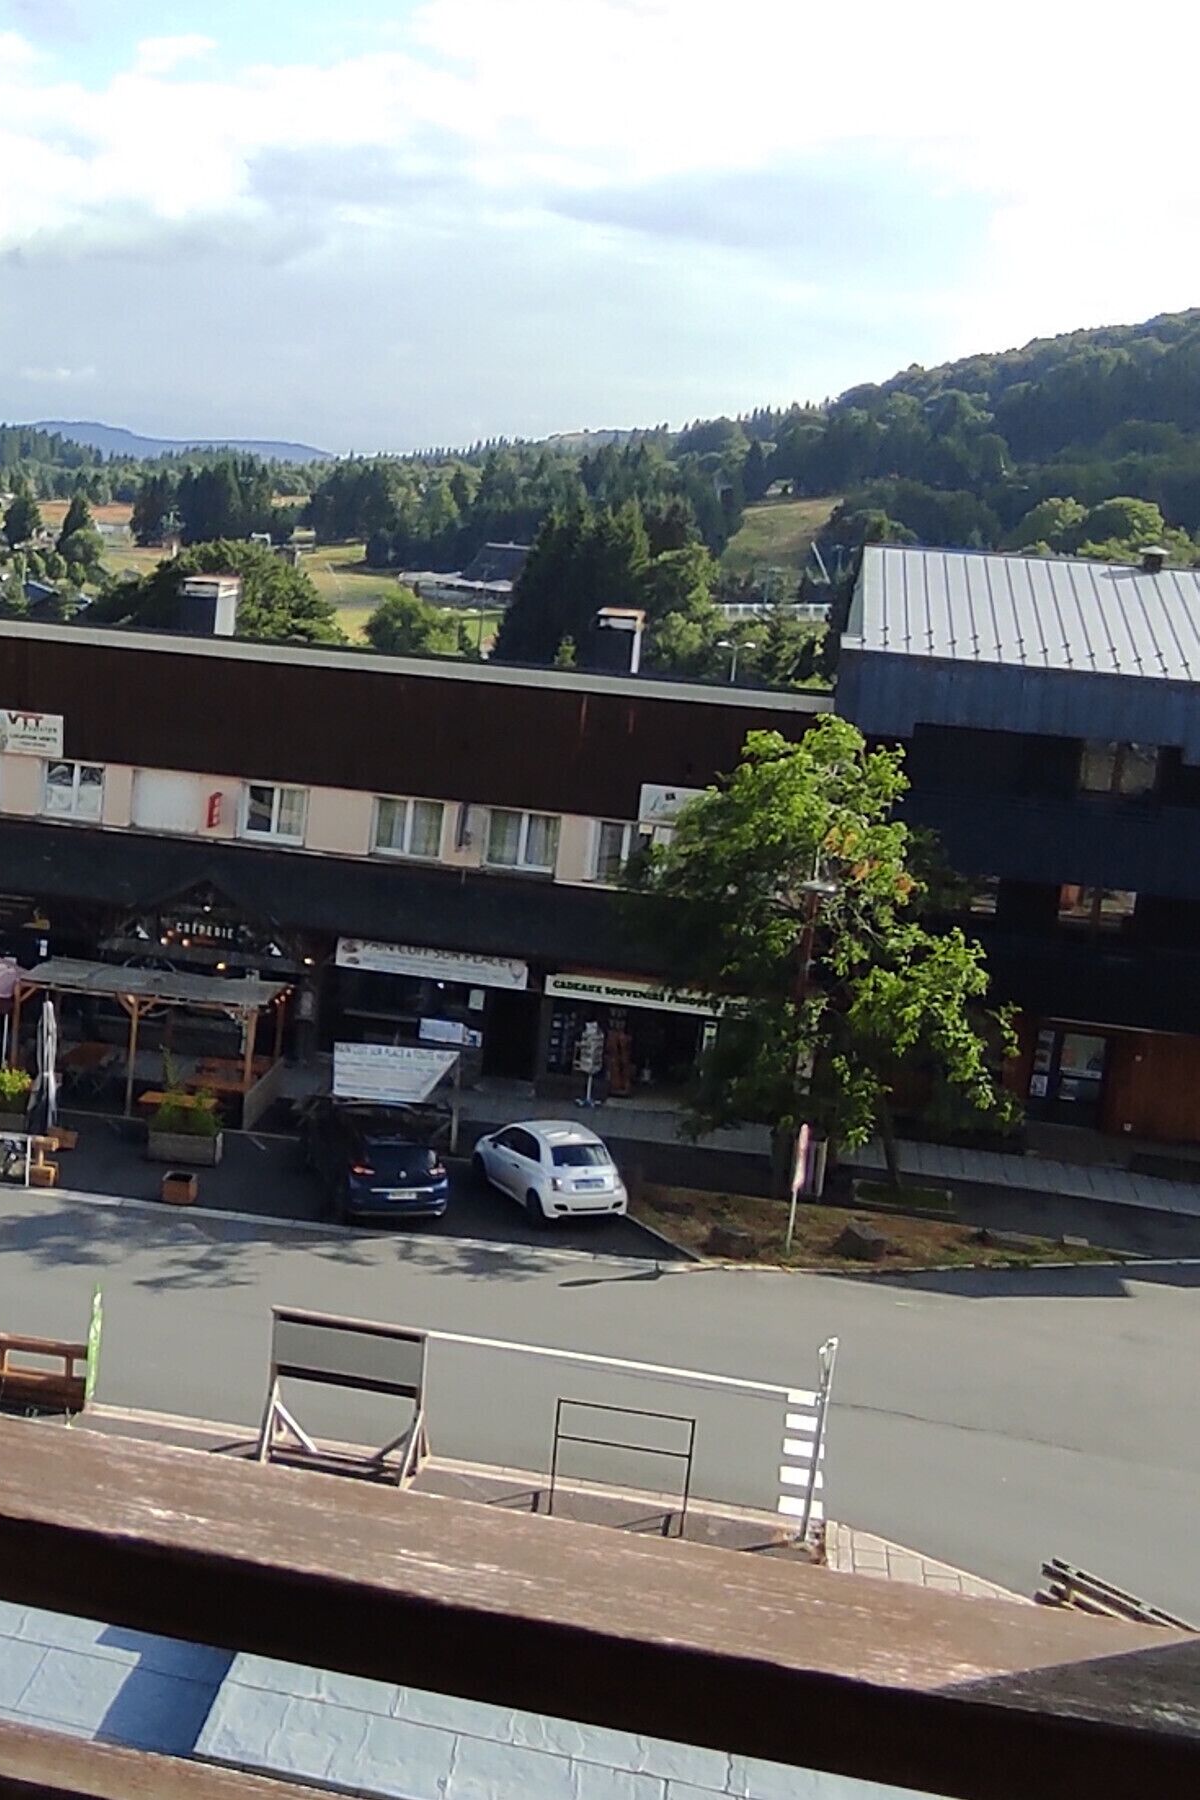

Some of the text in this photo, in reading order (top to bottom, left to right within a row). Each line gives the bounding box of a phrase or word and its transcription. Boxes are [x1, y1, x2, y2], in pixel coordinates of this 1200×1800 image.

[7, 712, 44, 731] VTT
[552, 979, 603, 995] CADEAUX
[604, 985, 665, 1003] SOUVENIRS
